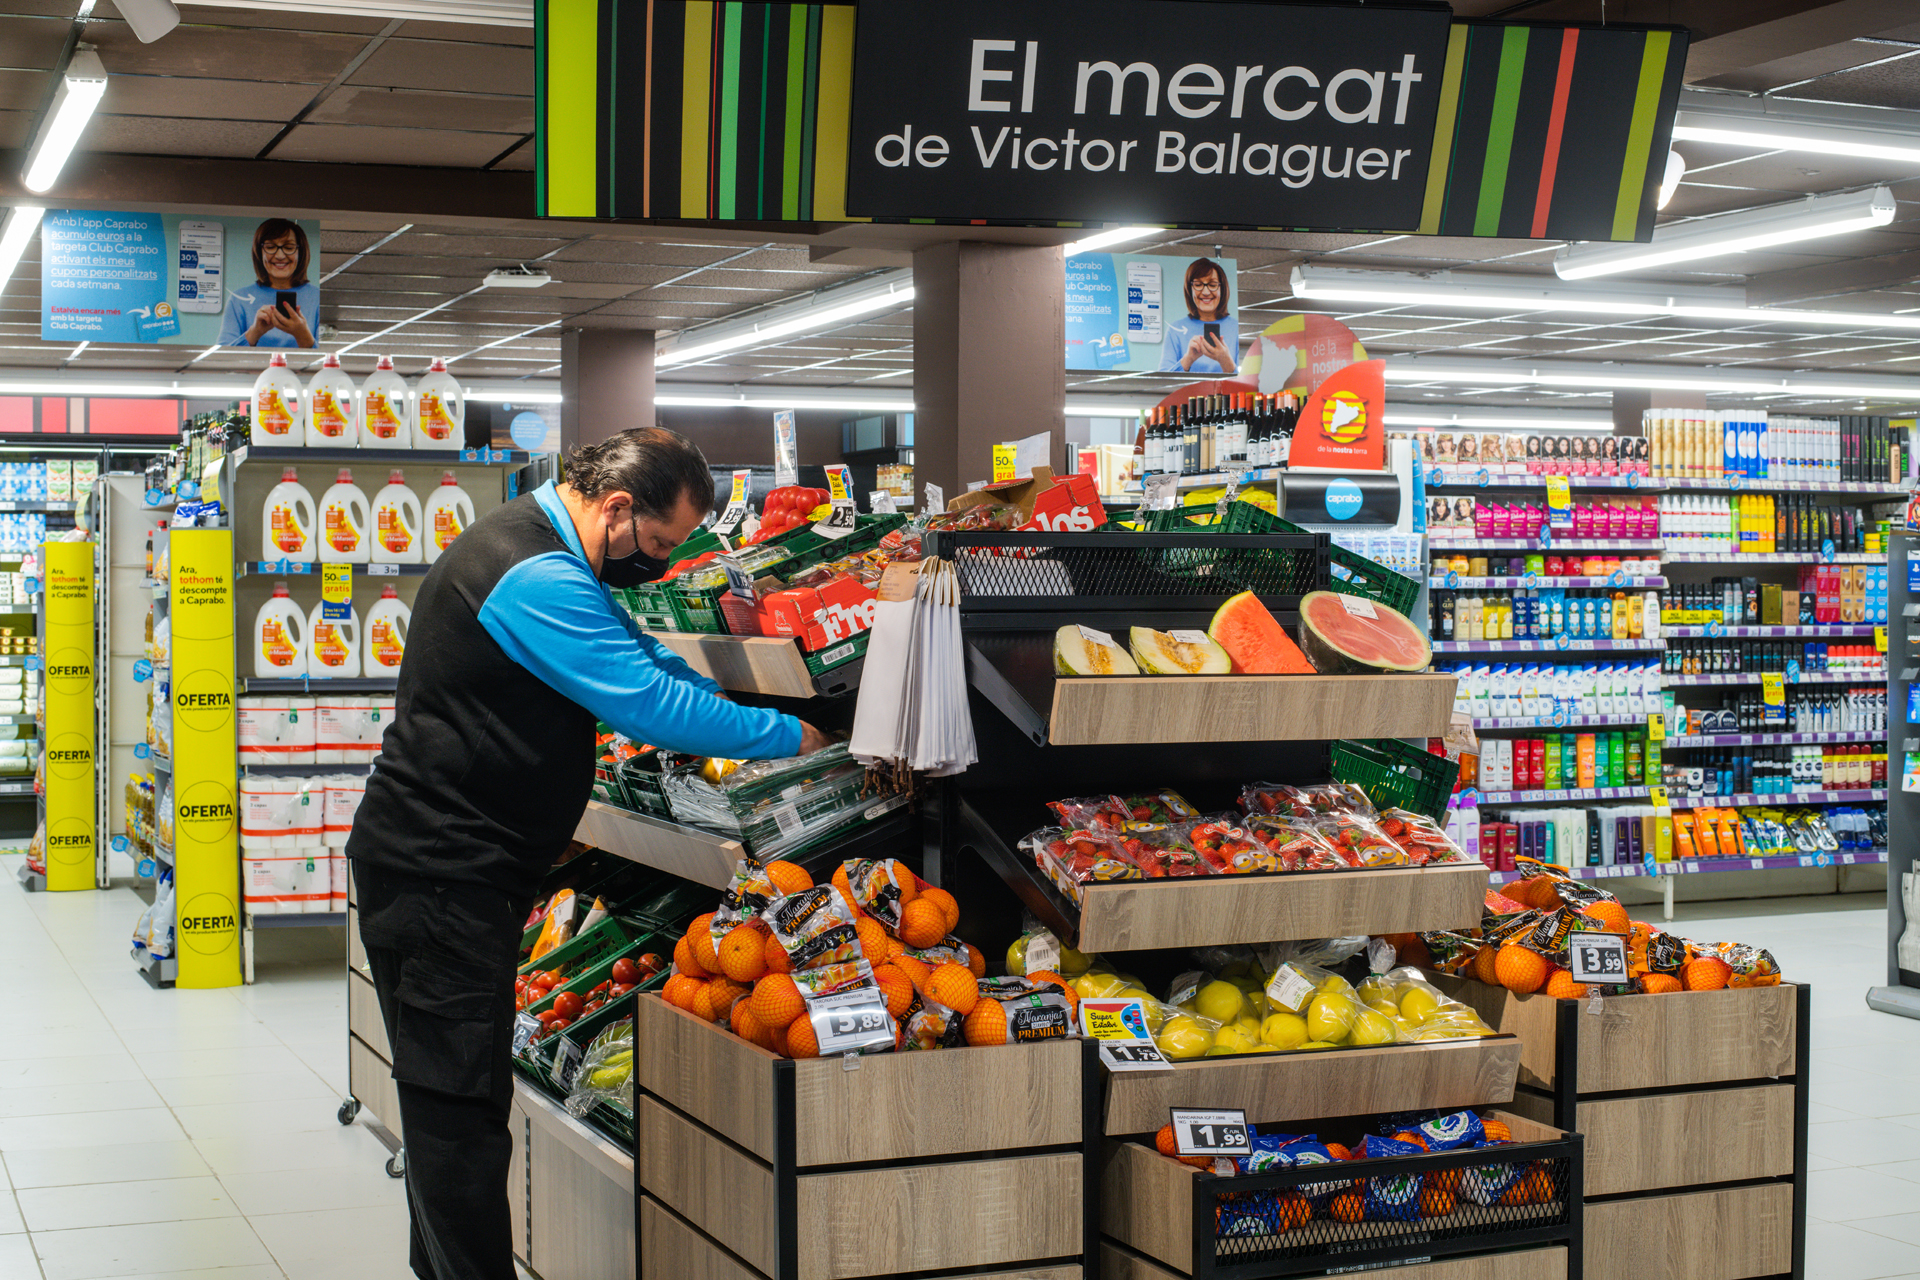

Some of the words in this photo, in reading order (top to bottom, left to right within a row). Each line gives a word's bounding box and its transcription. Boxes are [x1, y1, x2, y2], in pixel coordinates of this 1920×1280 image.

[967, 39, 1039, 113] El
[1073, 54, 1423, 124] mercat
[875, 125, 950, 168] de
[971, 126, 1138, 172] Victor
[1156, 131, 1411, 188] Balaguer
[51, 216, 77, 226] Amb
[103, 218, 148, 230] Caprabo
[51, 230, 95, 240] acumulo
[97, 232, 125, 241] euros
[134, 232, 143, 241] la
[51, 242, 87, 253] targeta
[89, 242, 113, 252] Club
[115, 243, 159, 255] Caprabo
[51, 254, 91, 264] activant
[92, 255, 106, 265] els
[107, 257, 136, 266] meus
[1068, 260, 1102, 270] Caprabo
[51, 267, 88, 278] cupons
[90, 267, 158, 279] personalitzats
[1092, 272, 1099, 280] la
[51, 279, 75, 288] cada
[77, 280, 122, 290] setmana.
[1077, 282, 1112, 292] Caprabo
[106, 307, 121, 315] més
[75, 315, 102, 324] targeta
[70, 322, 103, 331] Caprabo.
[1312, 340, 1325, 357] de
[1328, 339, 1337, 355] la
[1313, 357, 1347, 374] nostra
[1333, 446, 1353, 454] nostra
[996, 471, 1015, 481] grat
[1327, 494, 1361, 504] caprabo
[180, 566, 197, 574] Ara,
[180, 575, 214, 584] tothom
[215, 575, 223, 583] té
[180, 586, 227, 595] descompte
[325, 585, 350, 593] gratis
[57, 591, 87, 599] Caprabo.
[187, 596, 226, 606] Caprabo.
[49, 666, 90, 675] OFERTA
[178, 693, 231, 706] OFERTA
[49, 750, 91, 760] OFERTA
[180, 804, 233, 817] OFERTA
[49, 835, 91, 845] OFERTA
[785, 895, 829, 933] PREMIUM
[182, 915, 235, 929] OFERTA
[1549, 915, 1573, 949] PREMIUM
[1586, 948, 1622, 974] 3,99
[1018, 1009, 1065, 1026] Naranjas
[1090, 1013, 1114, 1021] Super
[1092, 1021, 1118, 1029] Estalvi
[1018, 1025, 1066, 1039] PREMIUM
[1115, 1046, 1160, 1061] 1,79
[1198, 1125, 1246, 1148] 1,99
